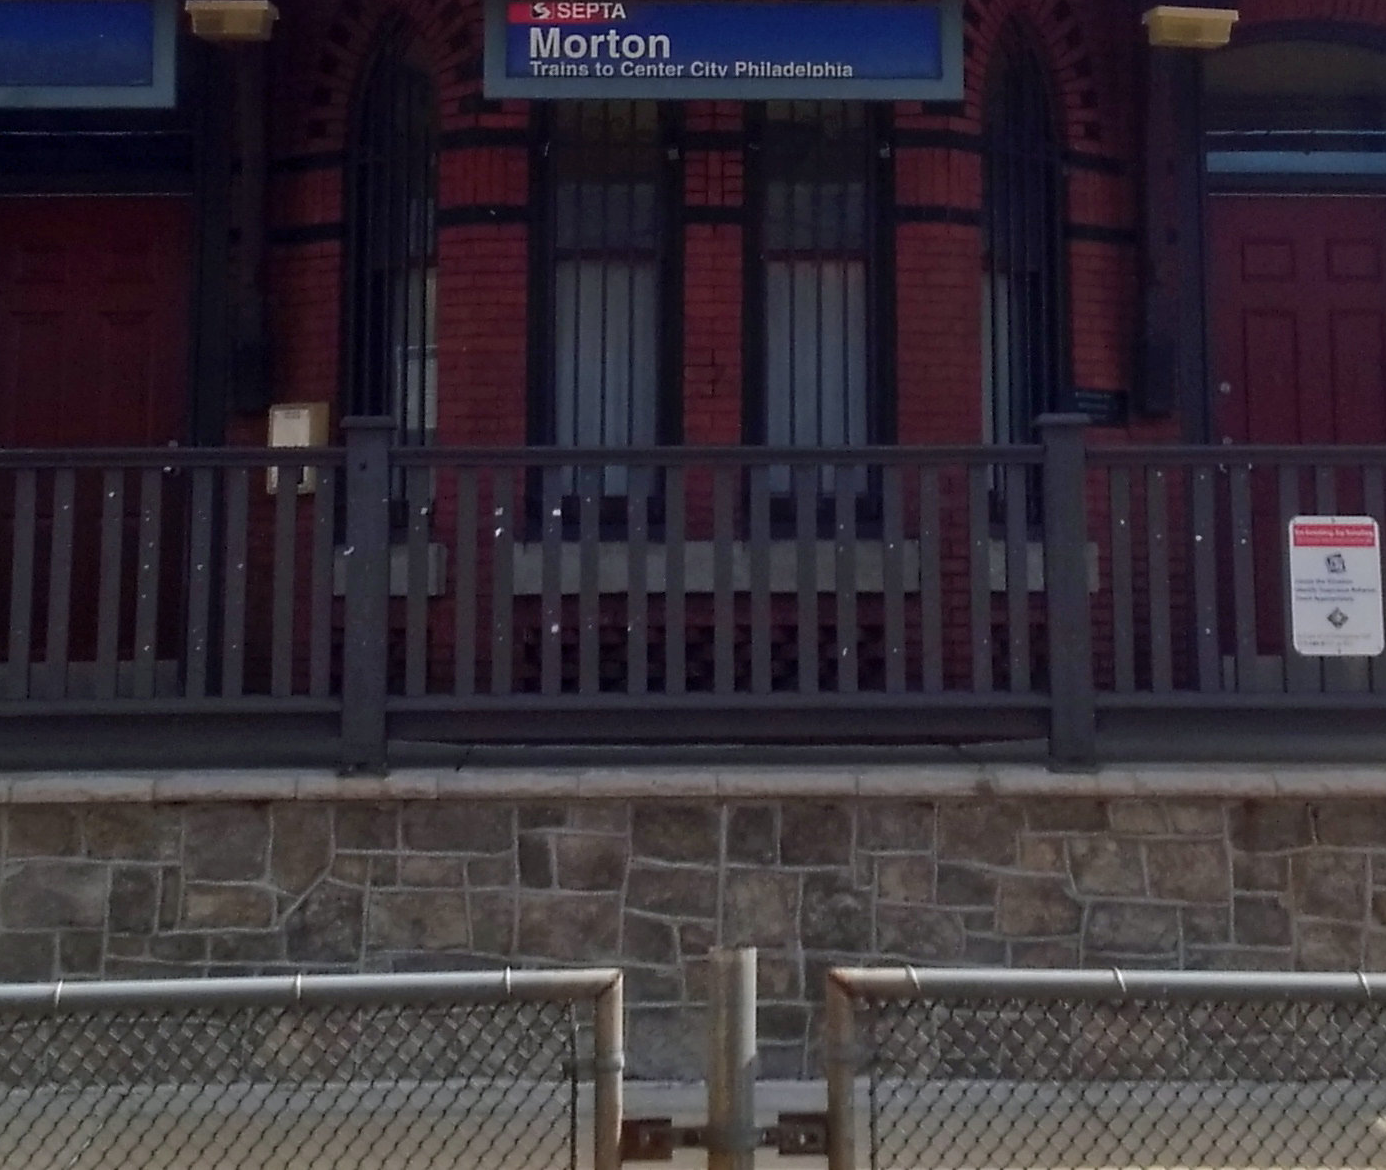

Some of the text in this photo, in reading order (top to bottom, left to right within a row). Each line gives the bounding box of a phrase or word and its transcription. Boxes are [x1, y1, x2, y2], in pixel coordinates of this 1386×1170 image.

[556, 2, 627, 20] SEPTA
[530, 27, 671, 59] Morton
[529, 61, 853, 77] Trains to Center City Philadelphia
